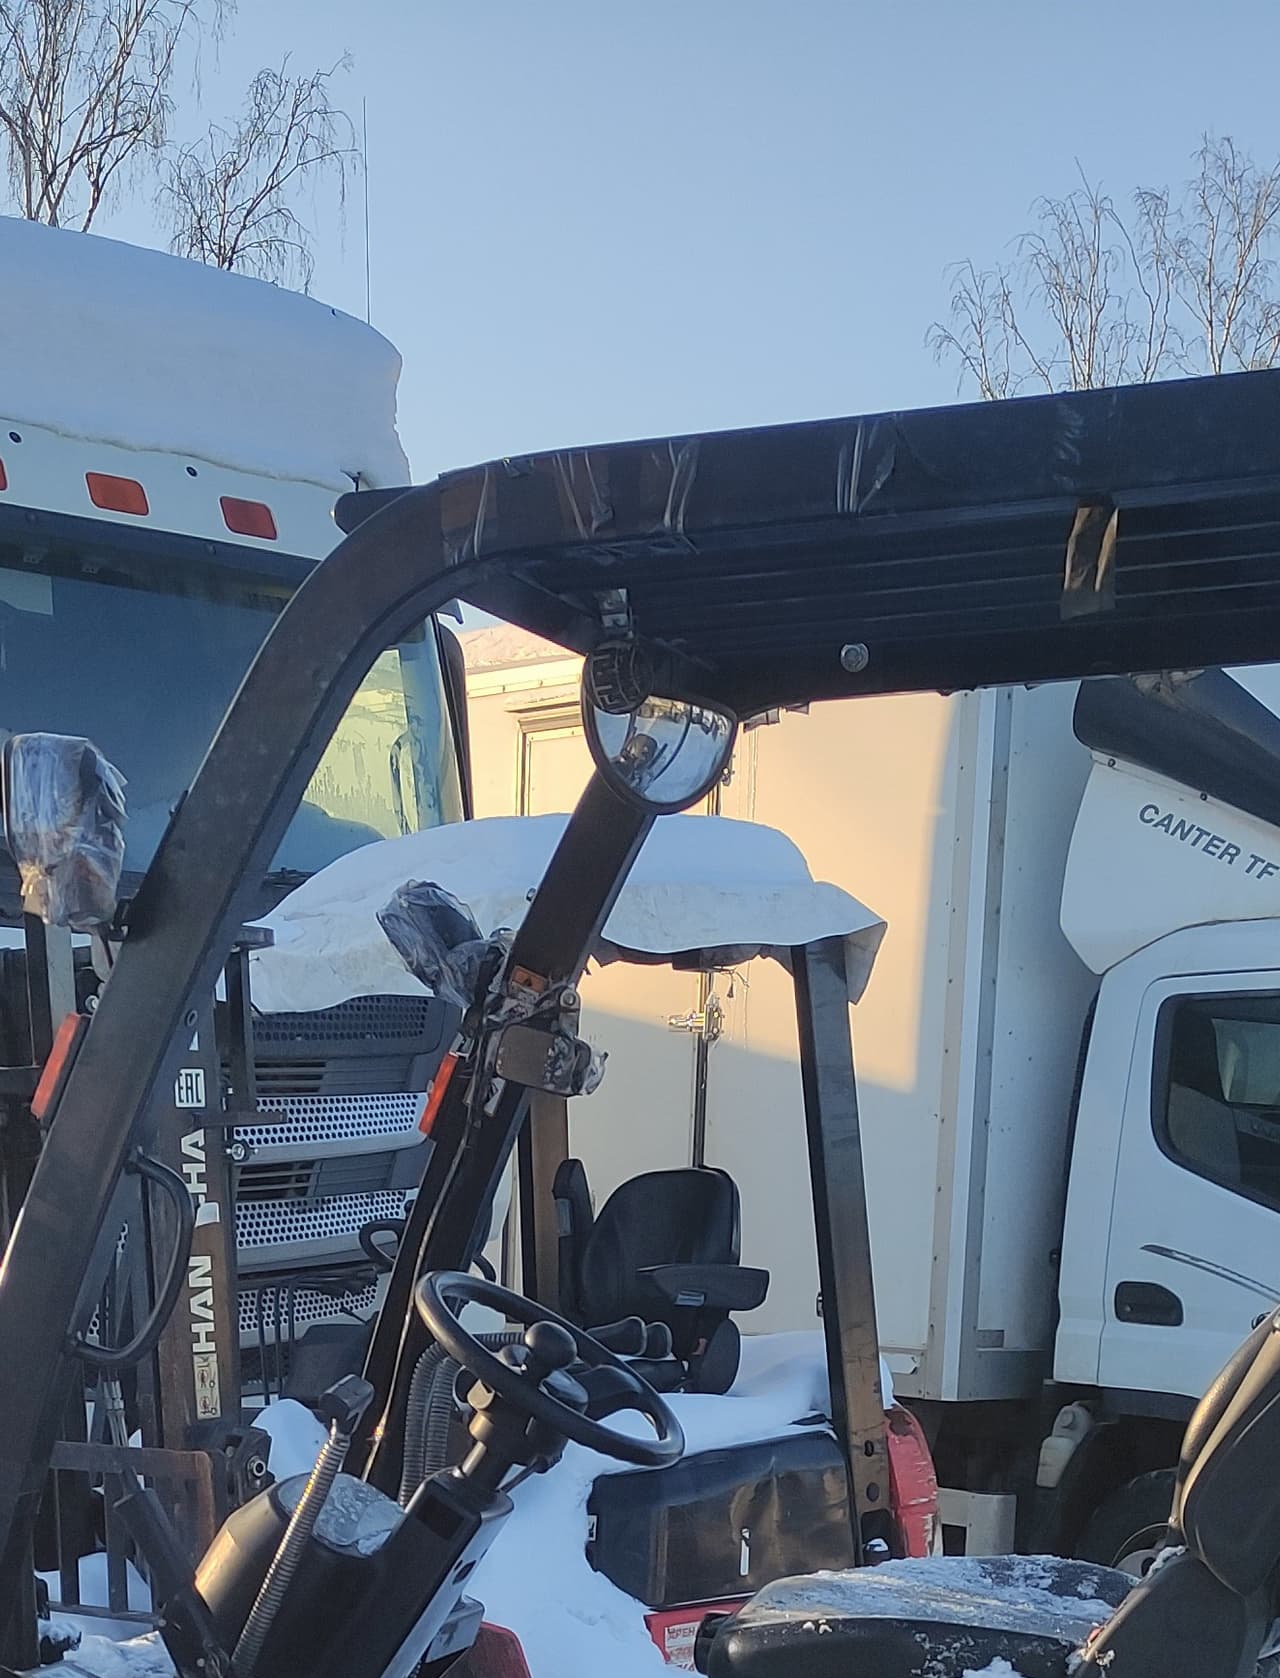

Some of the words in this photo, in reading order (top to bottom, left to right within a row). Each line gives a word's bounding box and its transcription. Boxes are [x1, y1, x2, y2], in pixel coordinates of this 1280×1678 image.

[1138, 803, 1241, 865] CANTER
[1245, 853, 1280, 880] TF
[179, 1072, 202, 1103] EAC
